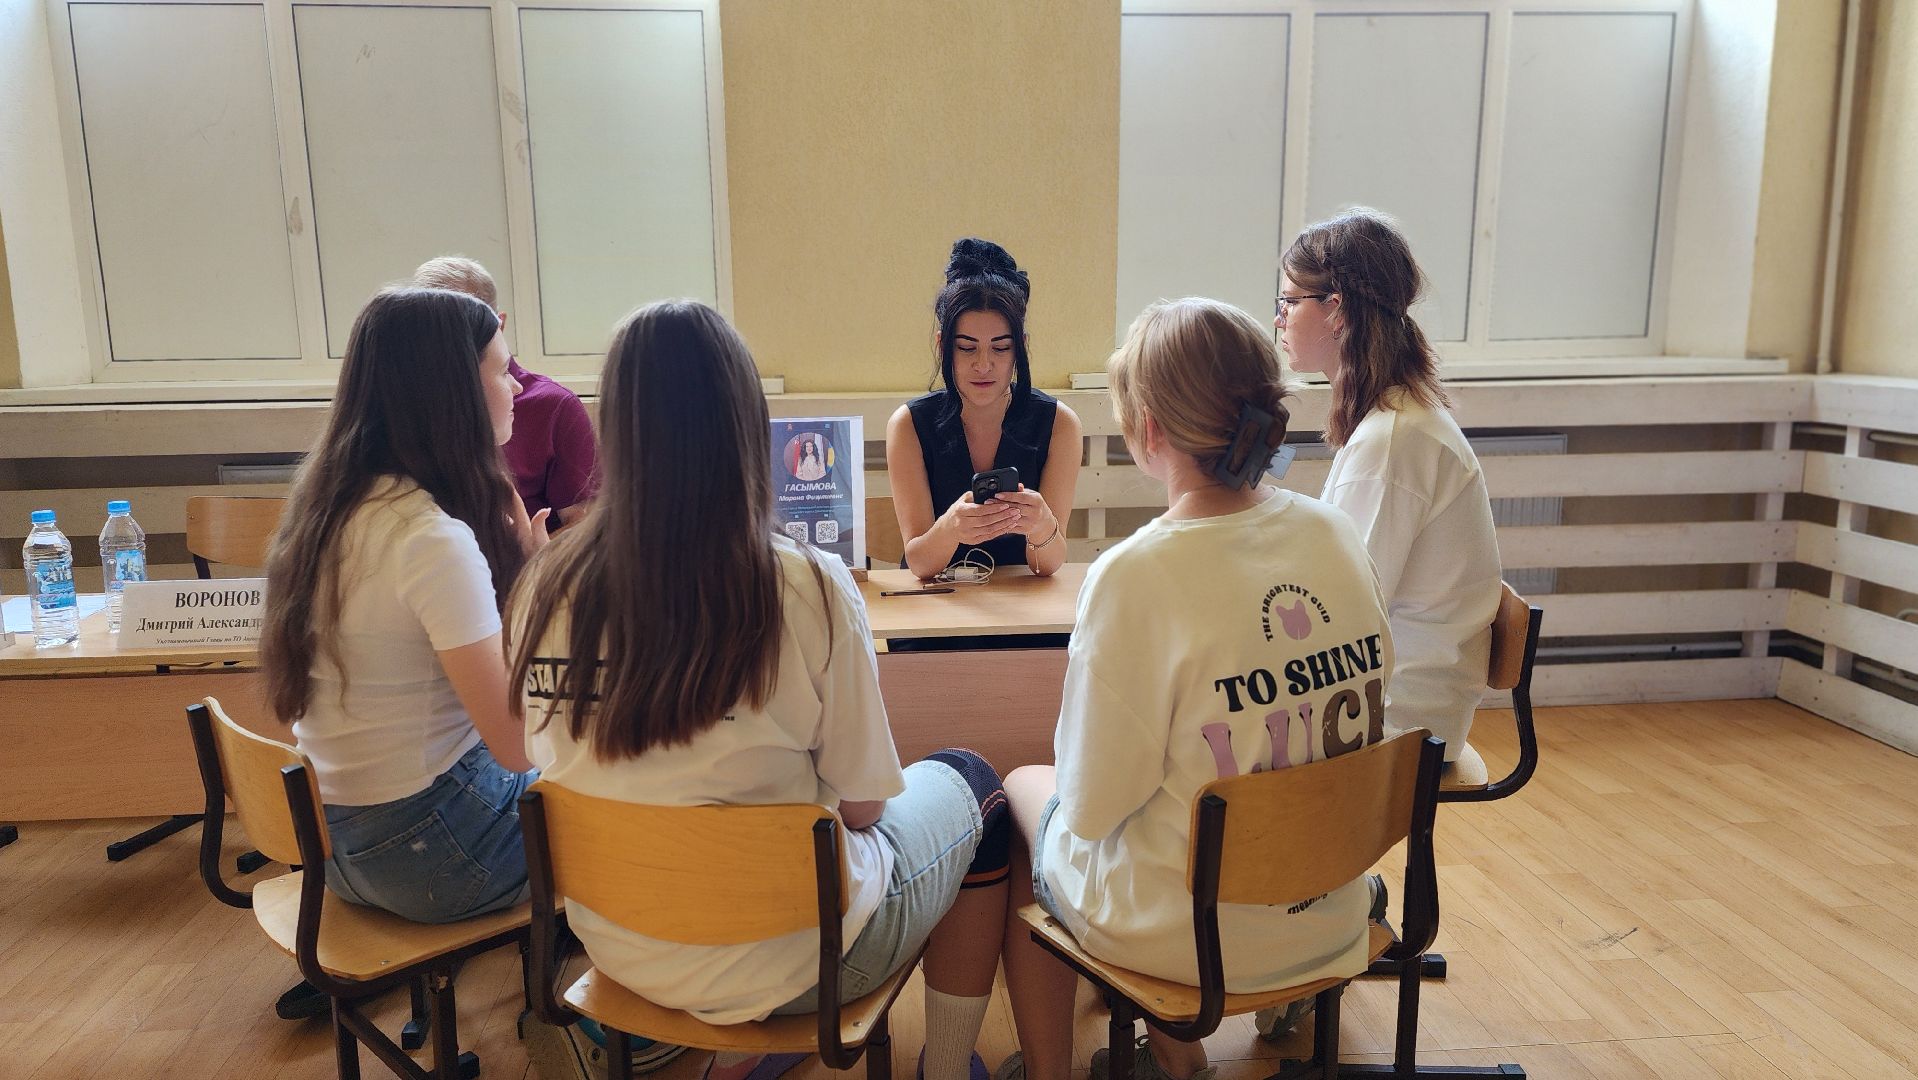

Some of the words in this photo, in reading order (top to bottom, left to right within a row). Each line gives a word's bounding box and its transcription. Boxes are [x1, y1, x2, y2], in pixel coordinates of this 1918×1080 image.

[784, 482, 837, 493] ГАСЫМОВА
[175, 590, 261, 609] ВОРОНОВ
[1262, 584, 1310, 614] BRIGHTEST
[1310, 596, 1331, 624] GUID
[135, 617, 194, 634] Дмитрий
[1262, 616, 1274, 642] THE
[1215, 668, 1278, 712] TO
[1284, 634, 1382, 696] SHINE
